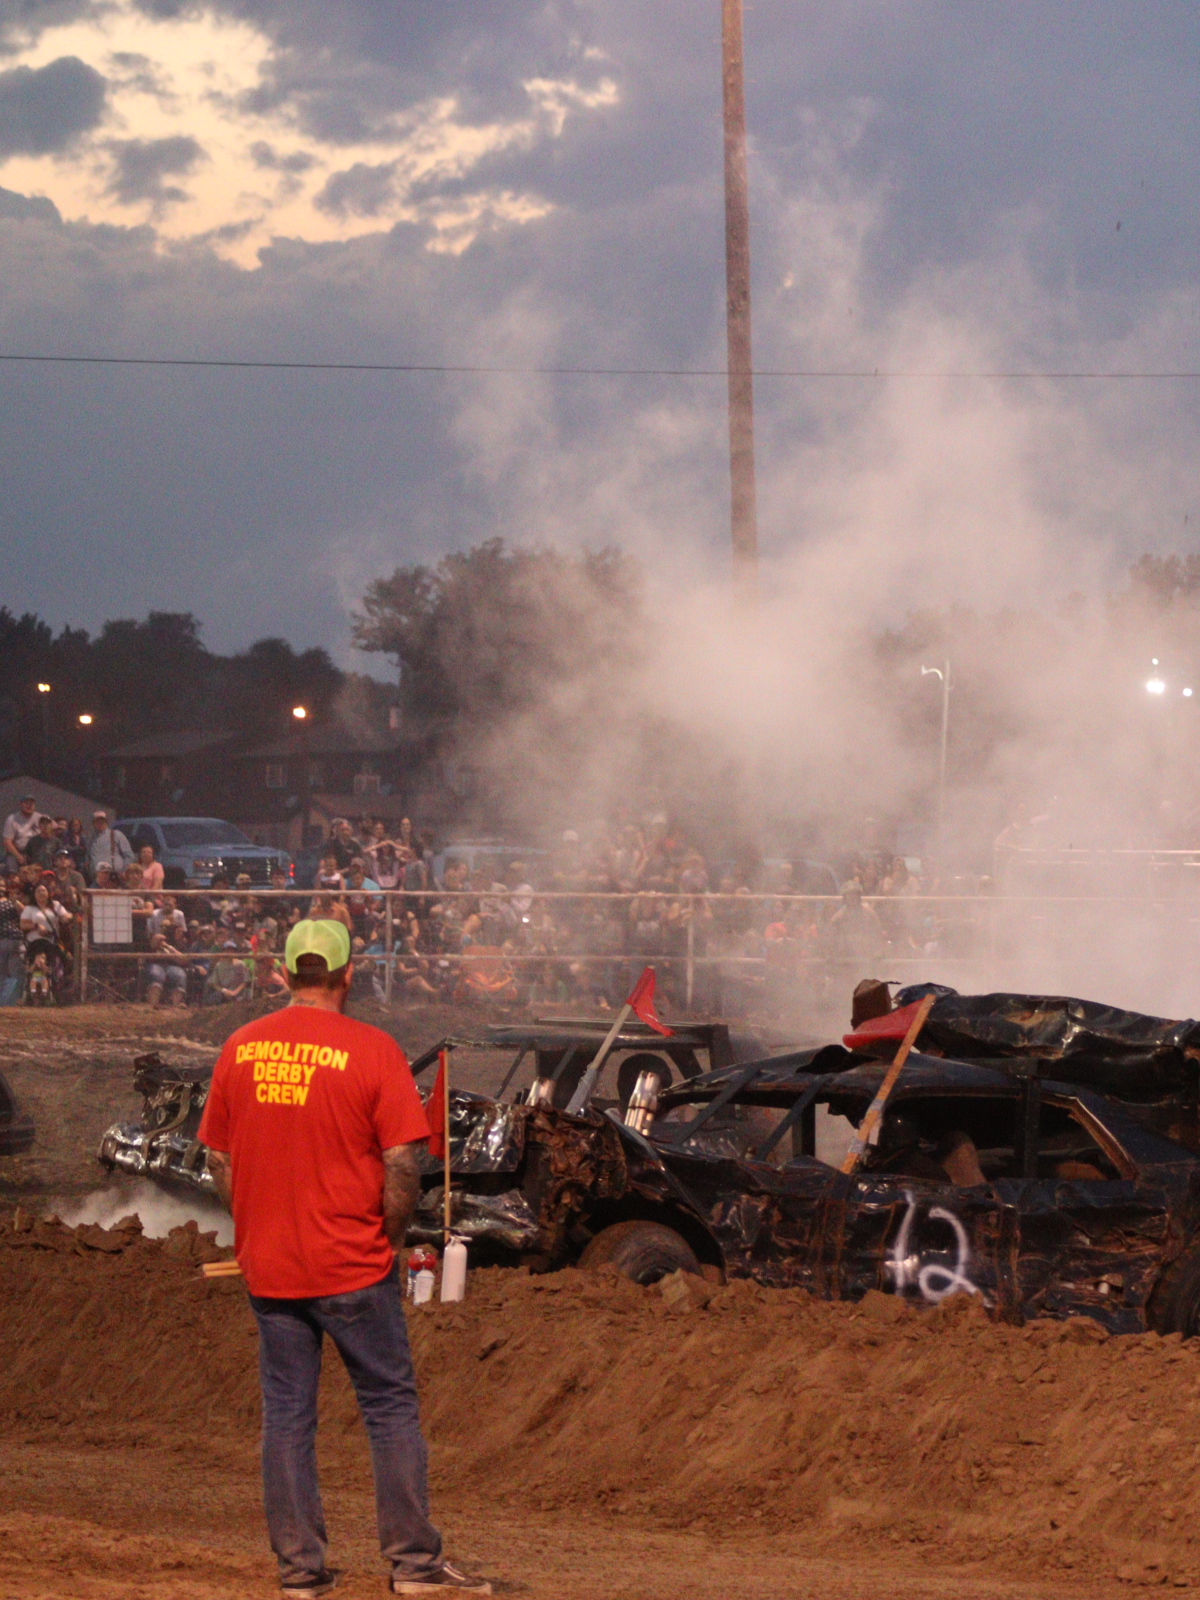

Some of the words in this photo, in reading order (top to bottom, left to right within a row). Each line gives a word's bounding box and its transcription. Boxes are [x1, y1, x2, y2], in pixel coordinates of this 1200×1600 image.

[235, 1040, 349, 1071] DEMOLITION
[253, 1061, 317, 1085] DERBY
[256, 1083, 309, 1106] CREW
[892, 1187, 988, 1305] 12
